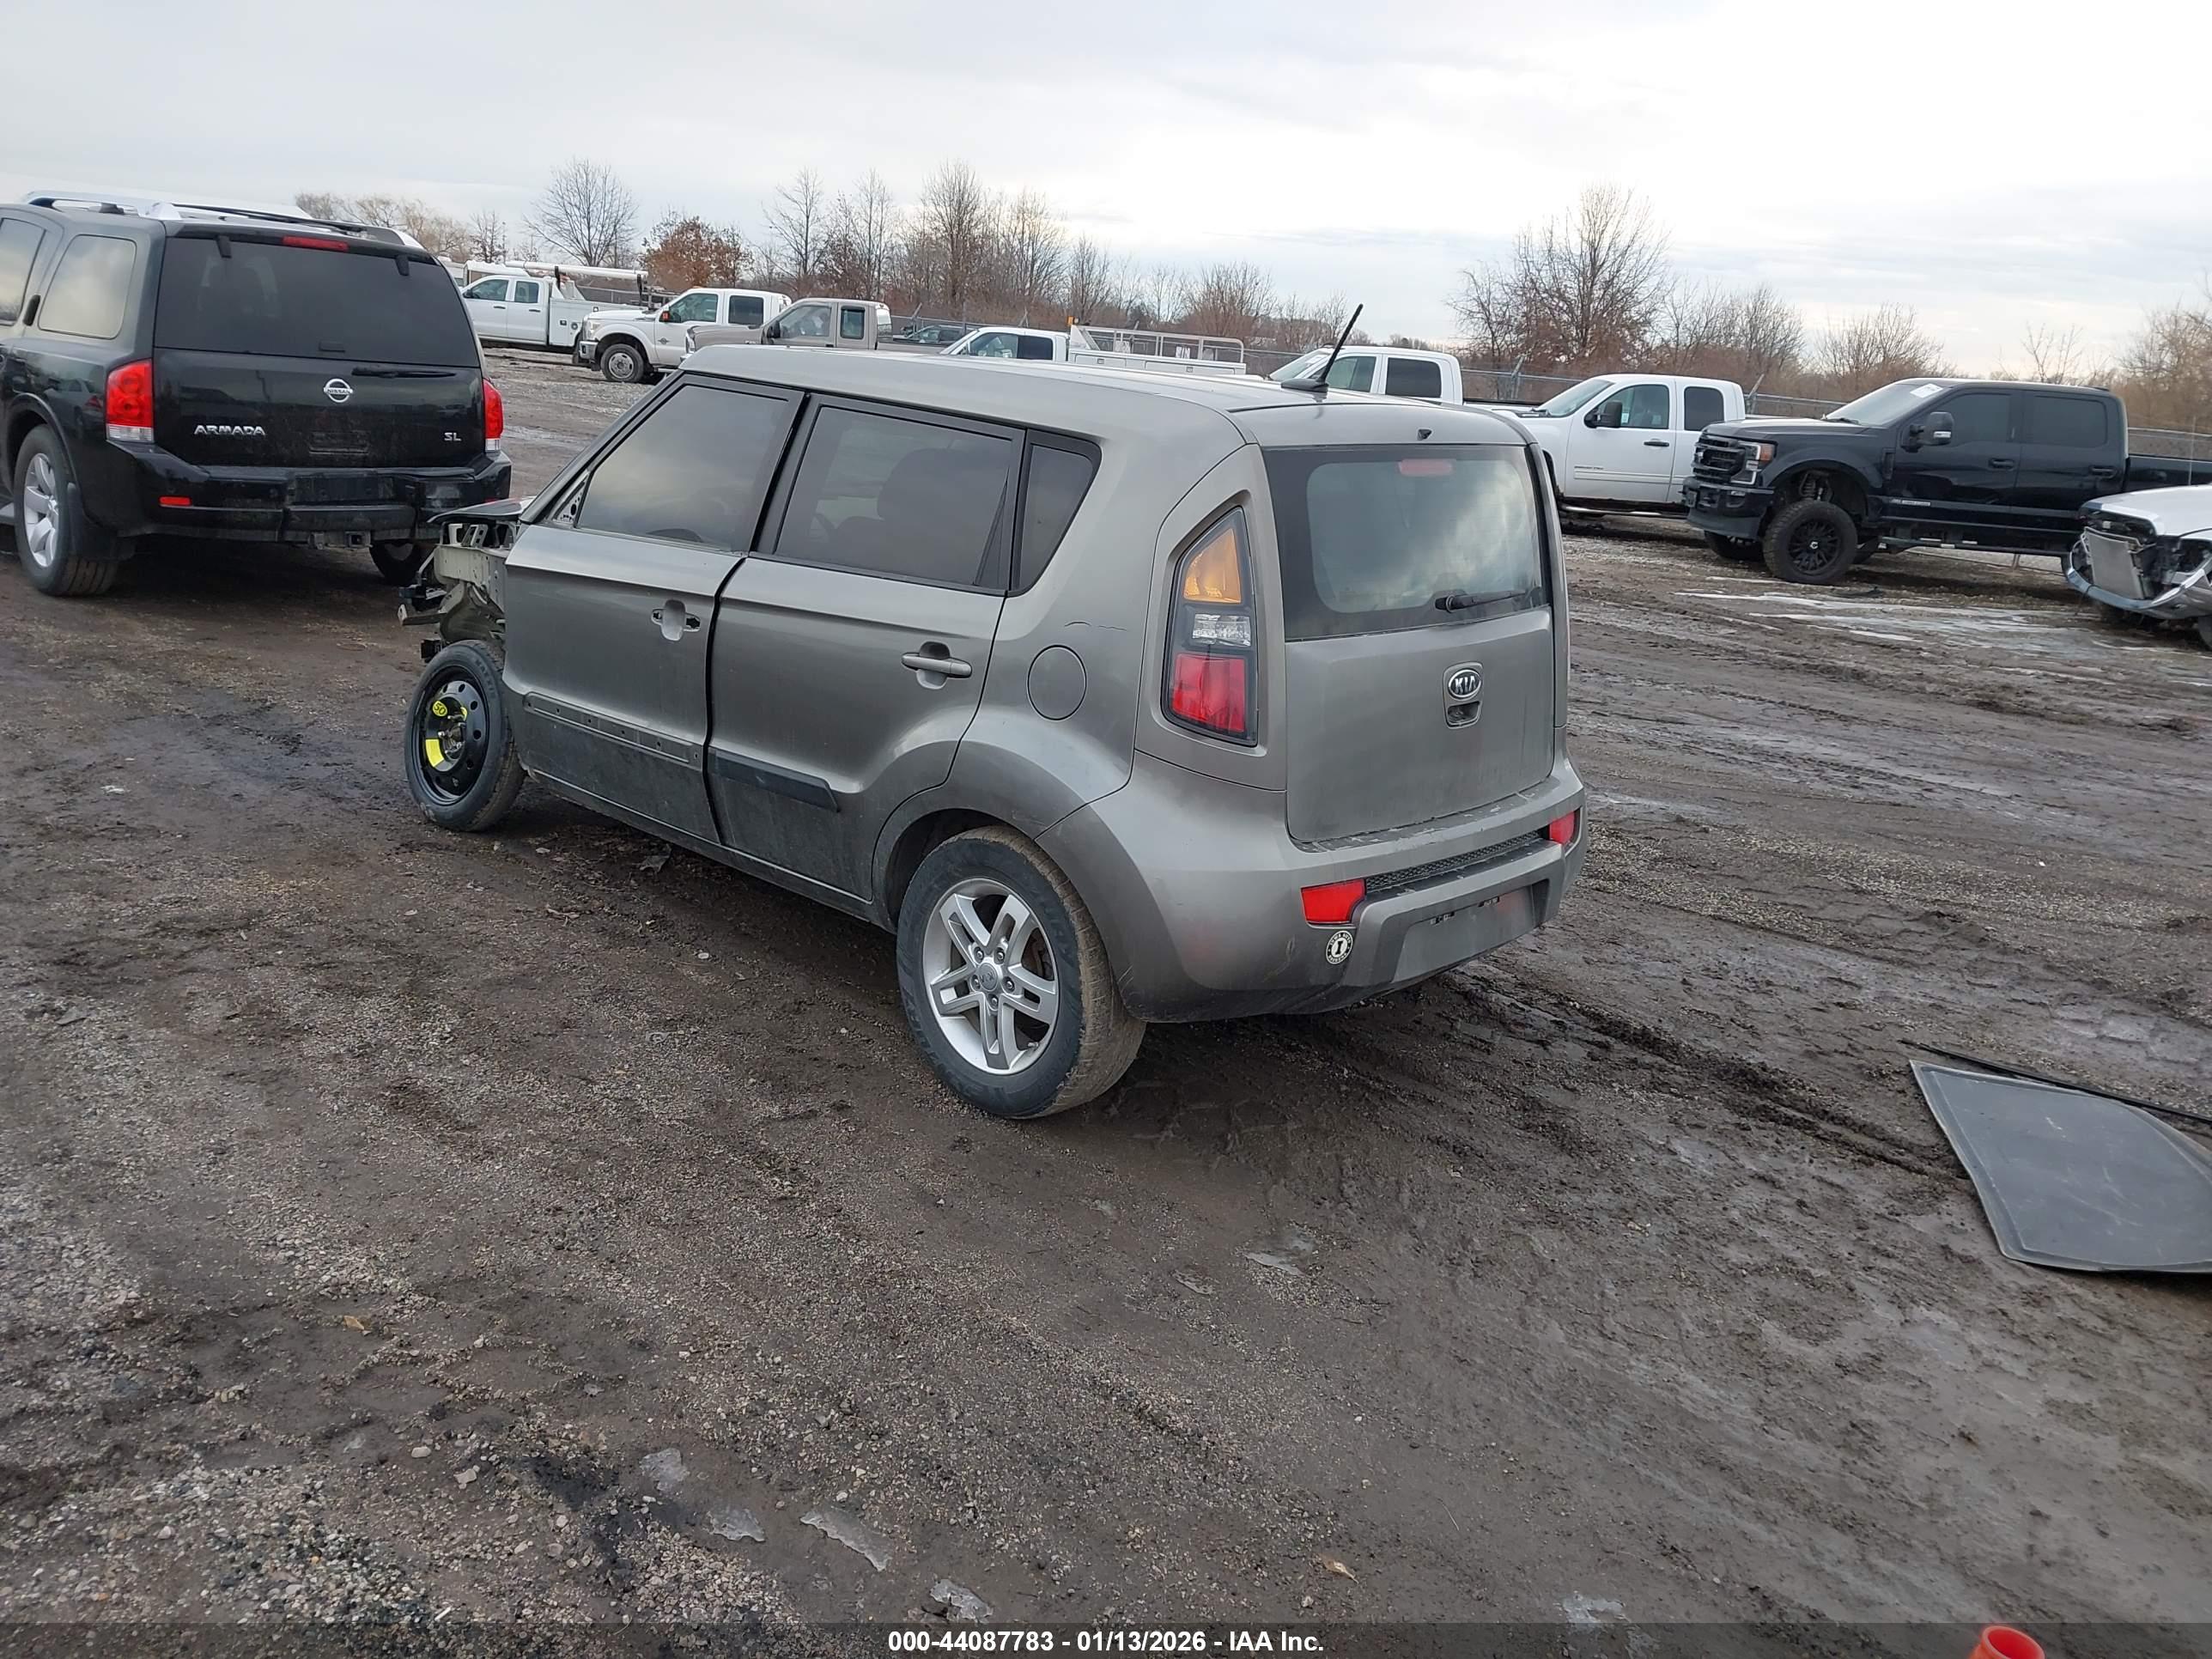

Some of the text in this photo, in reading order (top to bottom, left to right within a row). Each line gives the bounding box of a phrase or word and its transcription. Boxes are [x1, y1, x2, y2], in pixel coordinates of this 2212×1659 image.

[194, 425, 265, 435] ARMADA
[444, 432, 462, 441] SL
[1455, 676, 1476, 694] KIA
[434, 703, 446, 714] 50
